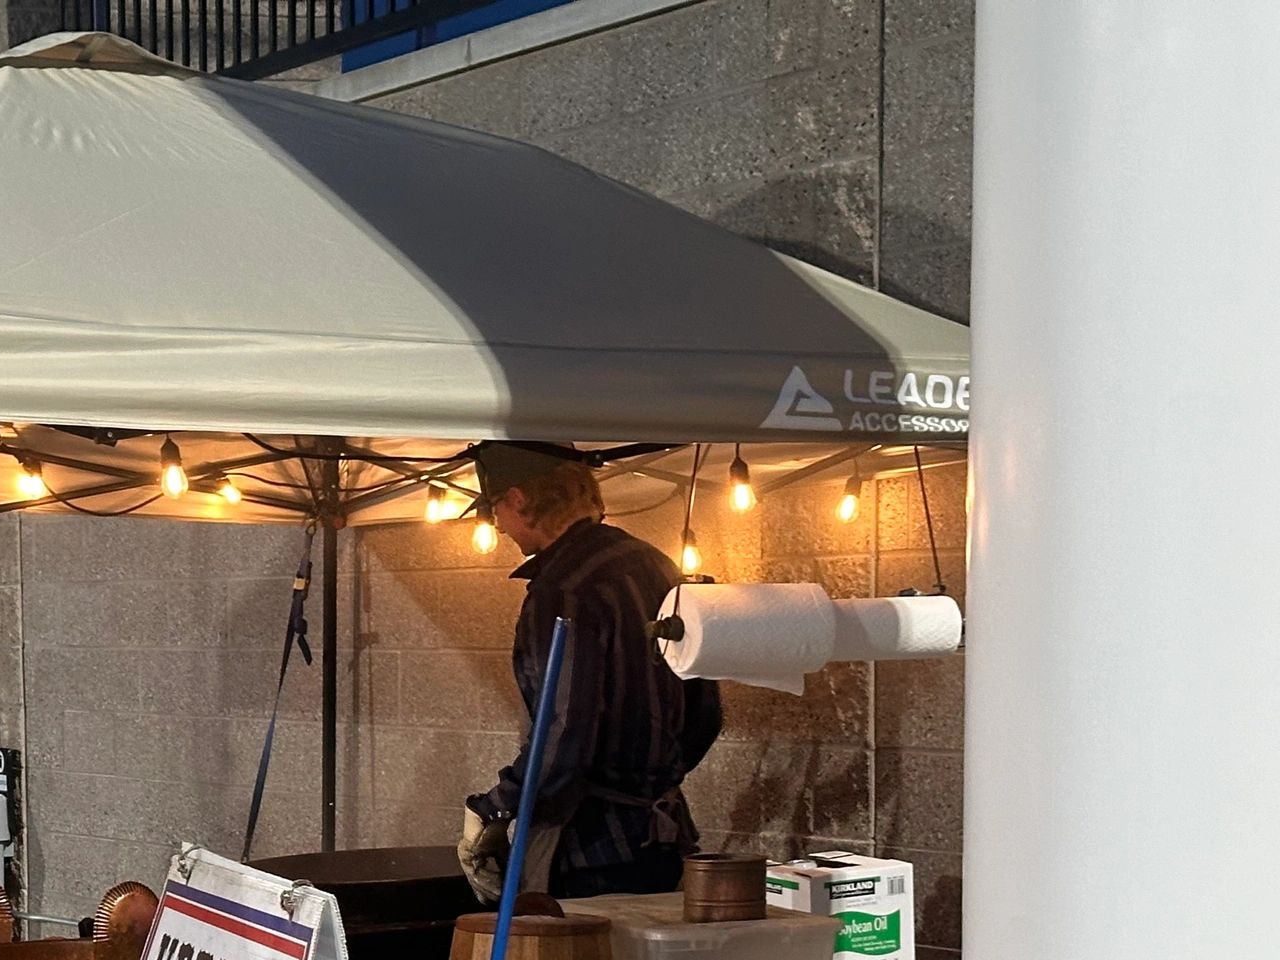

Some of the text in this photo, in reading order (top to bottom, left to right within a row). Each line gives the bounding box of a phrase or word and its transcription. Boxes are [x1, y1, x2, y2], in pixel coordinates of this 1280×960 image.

[831, 881, 874, 893] KIRKLAND
[838, 916, 888, 938] oybean Oil
